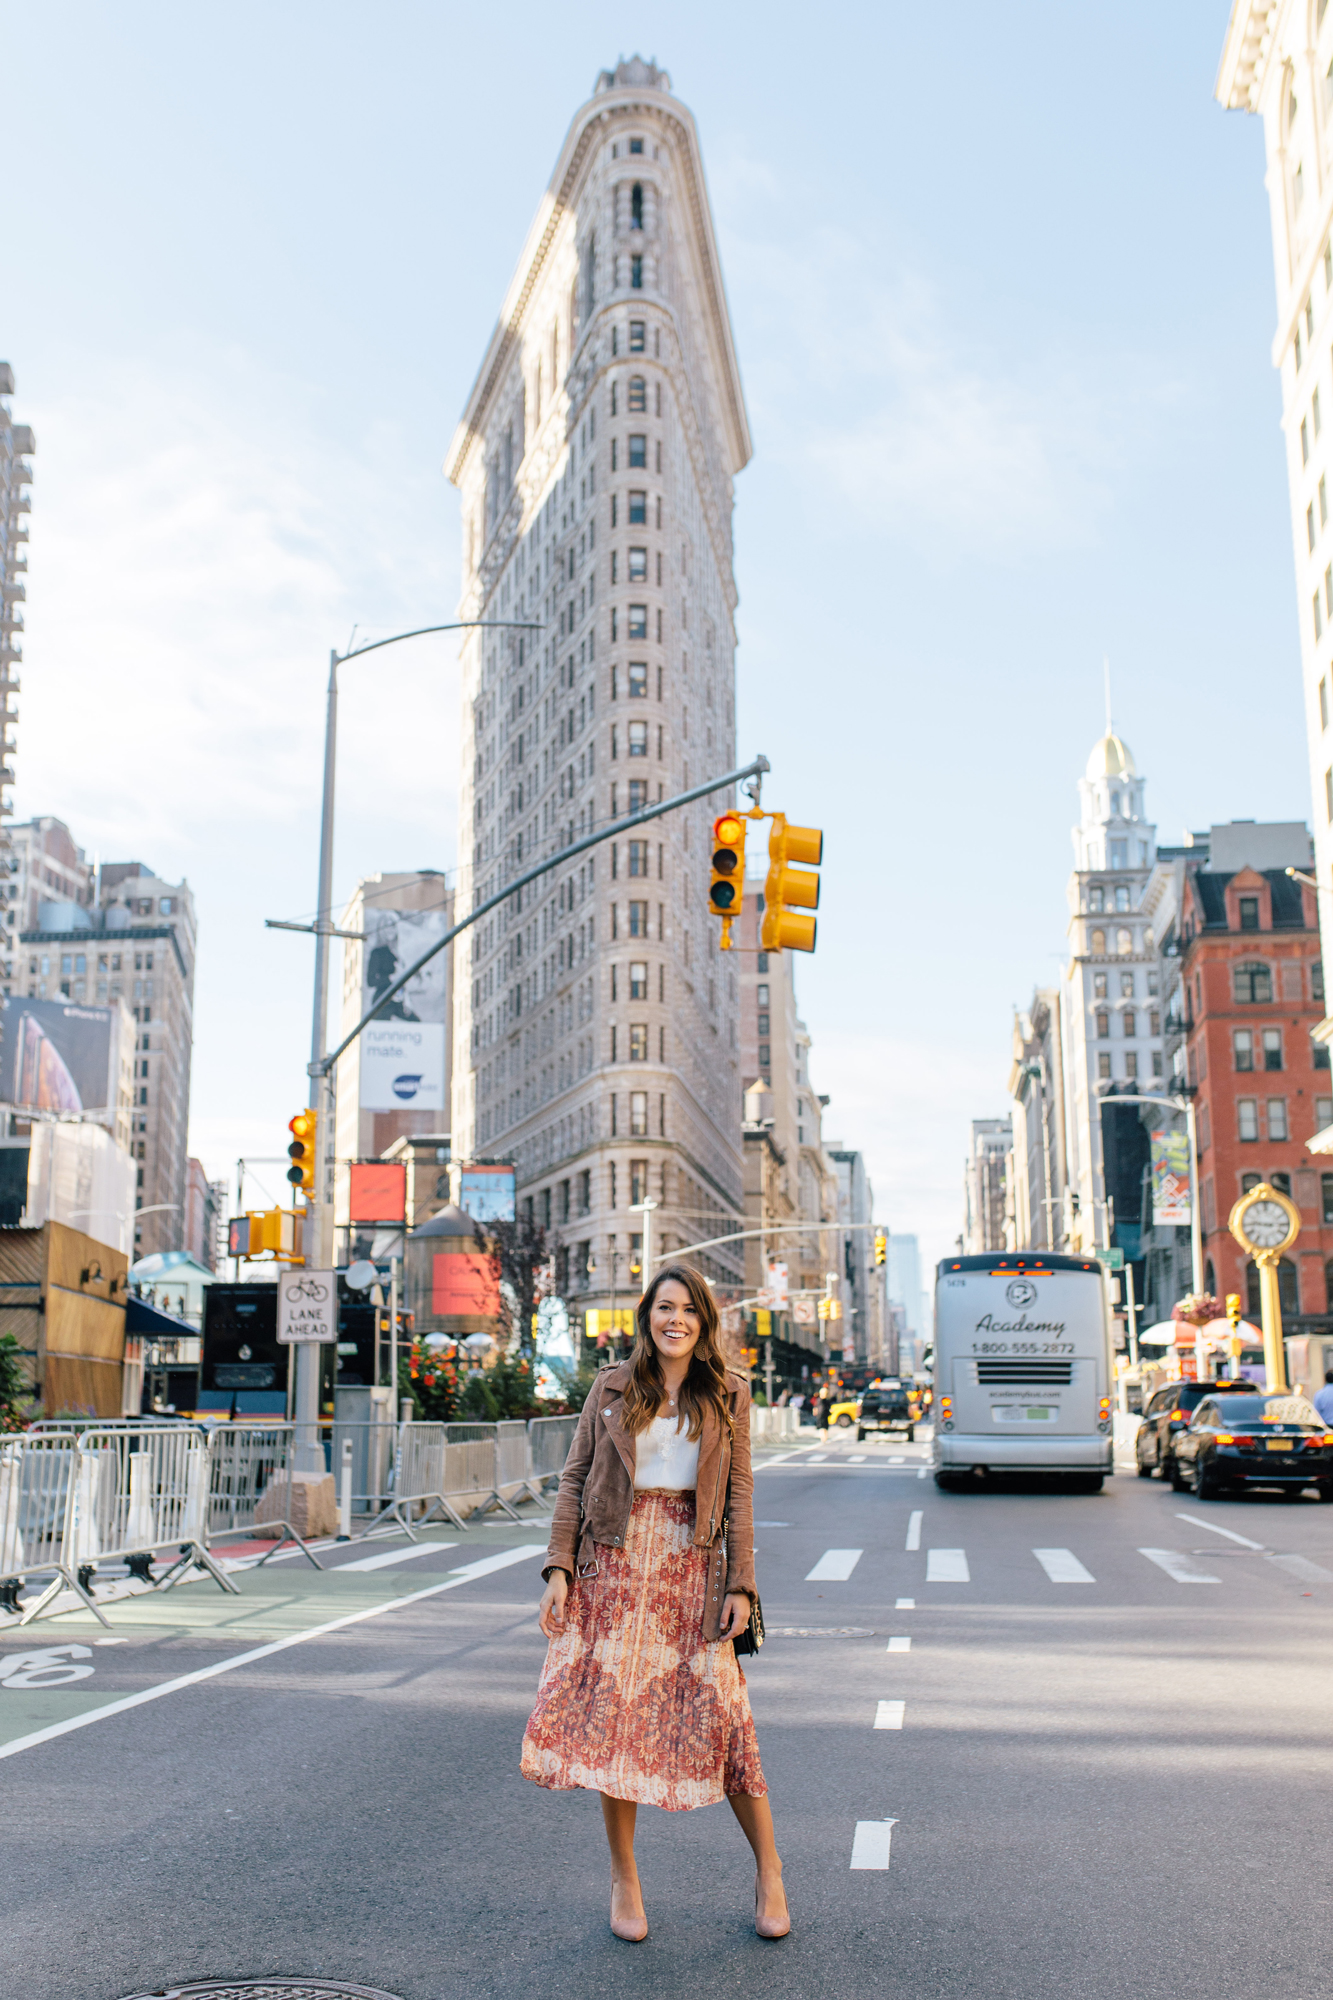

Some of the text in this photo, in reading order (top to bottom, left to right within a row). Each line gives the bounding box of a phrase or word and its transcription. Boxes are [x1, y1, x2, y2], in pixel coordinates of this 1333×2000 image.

[367, 1029, 422, 1046] running
[290, 1308, 323, 1321] LANE
[285, 1323, 329, 1335] AHEAD
[975, 1312, 1067, 1339] Academy
[972, 1342, 1076, 1354] 1-800-555-2872
[988, 1390, 1061, 1400] academybus.com
